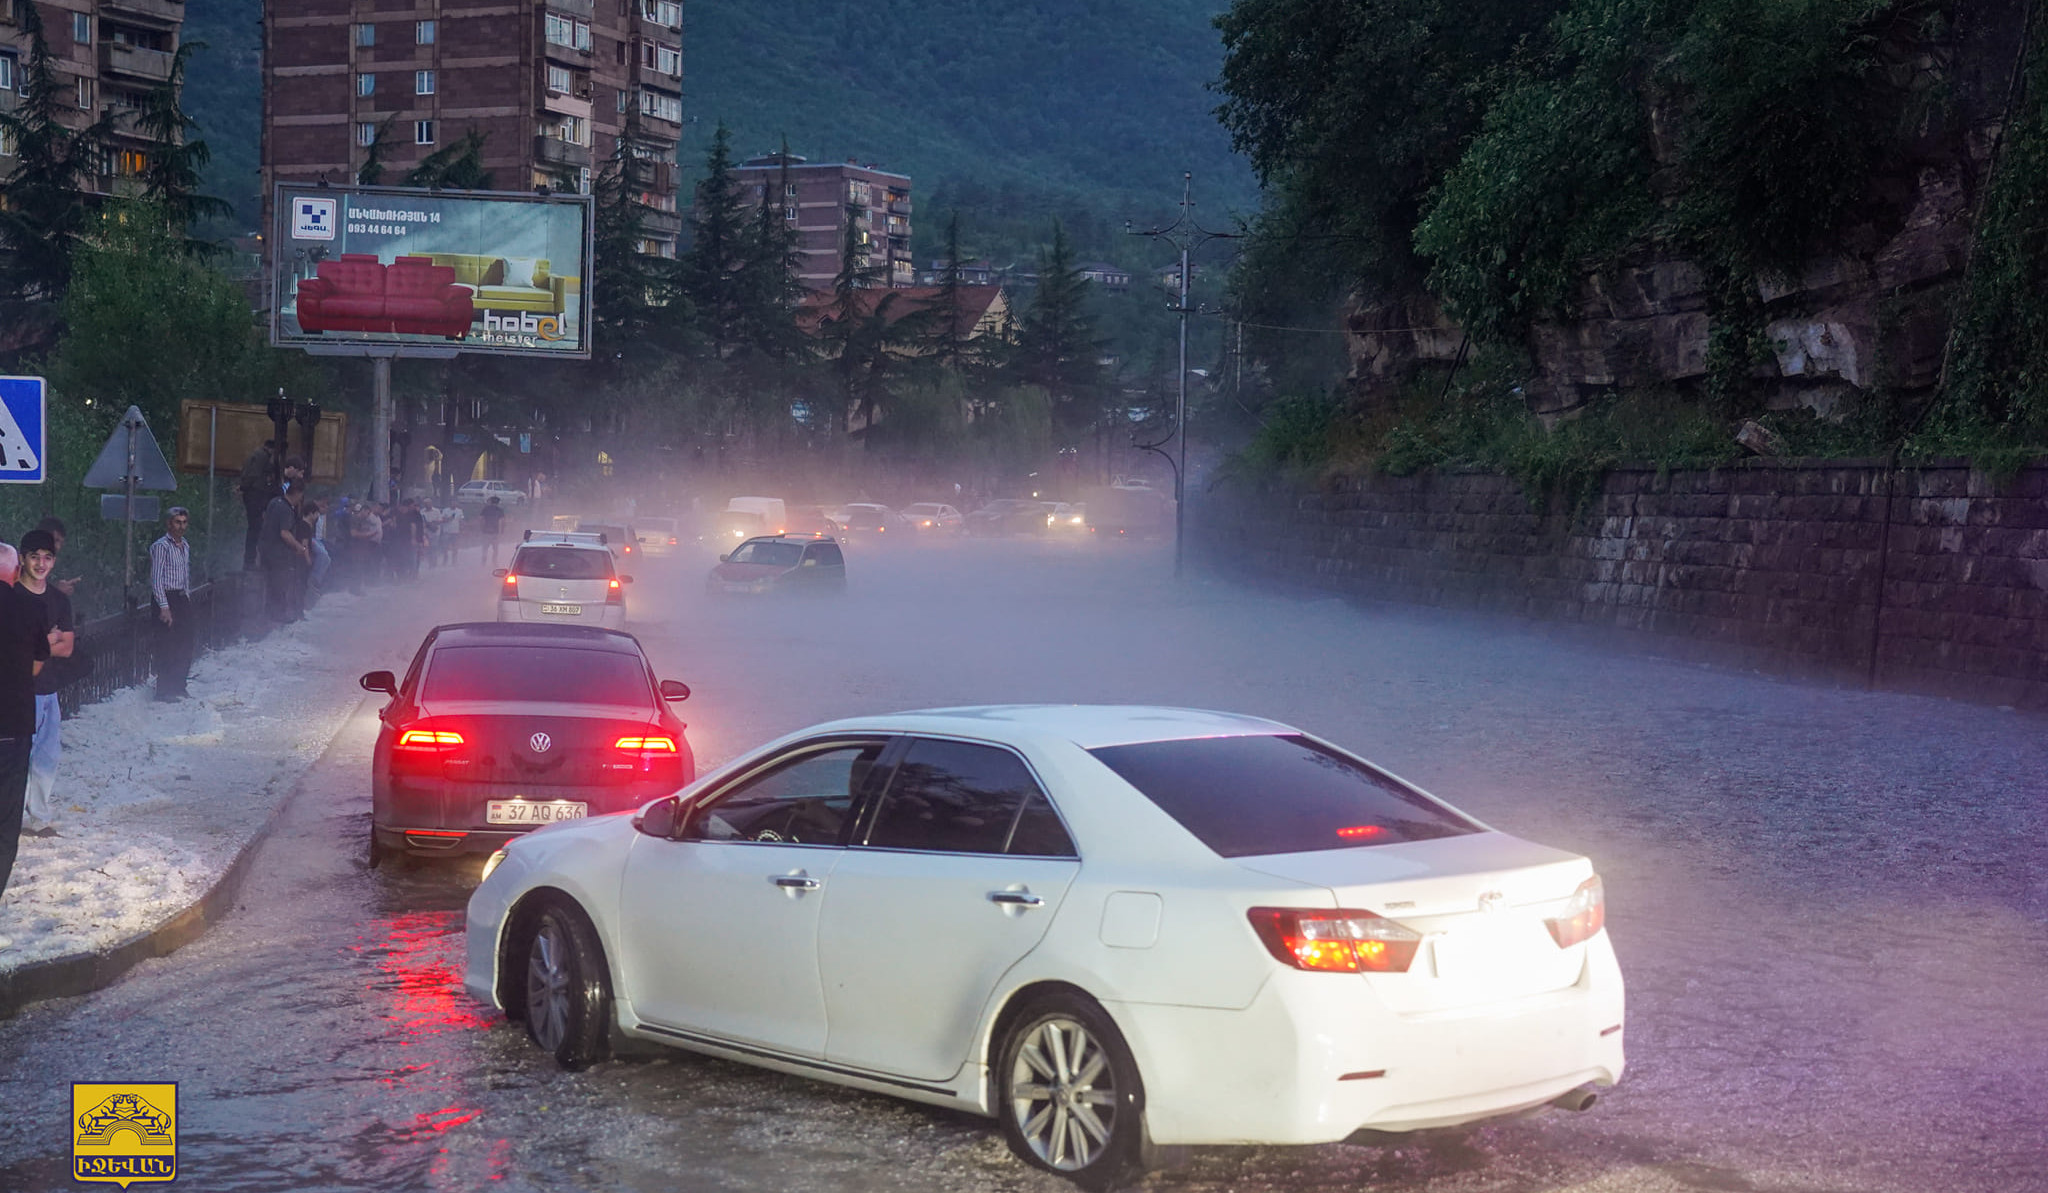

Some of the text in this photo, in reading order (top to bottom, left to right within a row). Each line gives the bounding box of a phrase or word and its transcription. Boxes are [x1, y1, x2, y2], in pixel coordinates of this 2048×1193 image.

[348, 207, 441, 223] ԱՆԿԱԽՈՒԹՅԱՆ 14
[347, 223, 406, 235] 093 44 64 64
[484, 308, 565, 341] hobel
[483, 332, 538, 344] meister
[508, 805, 582, 820] 37 AQ 636
